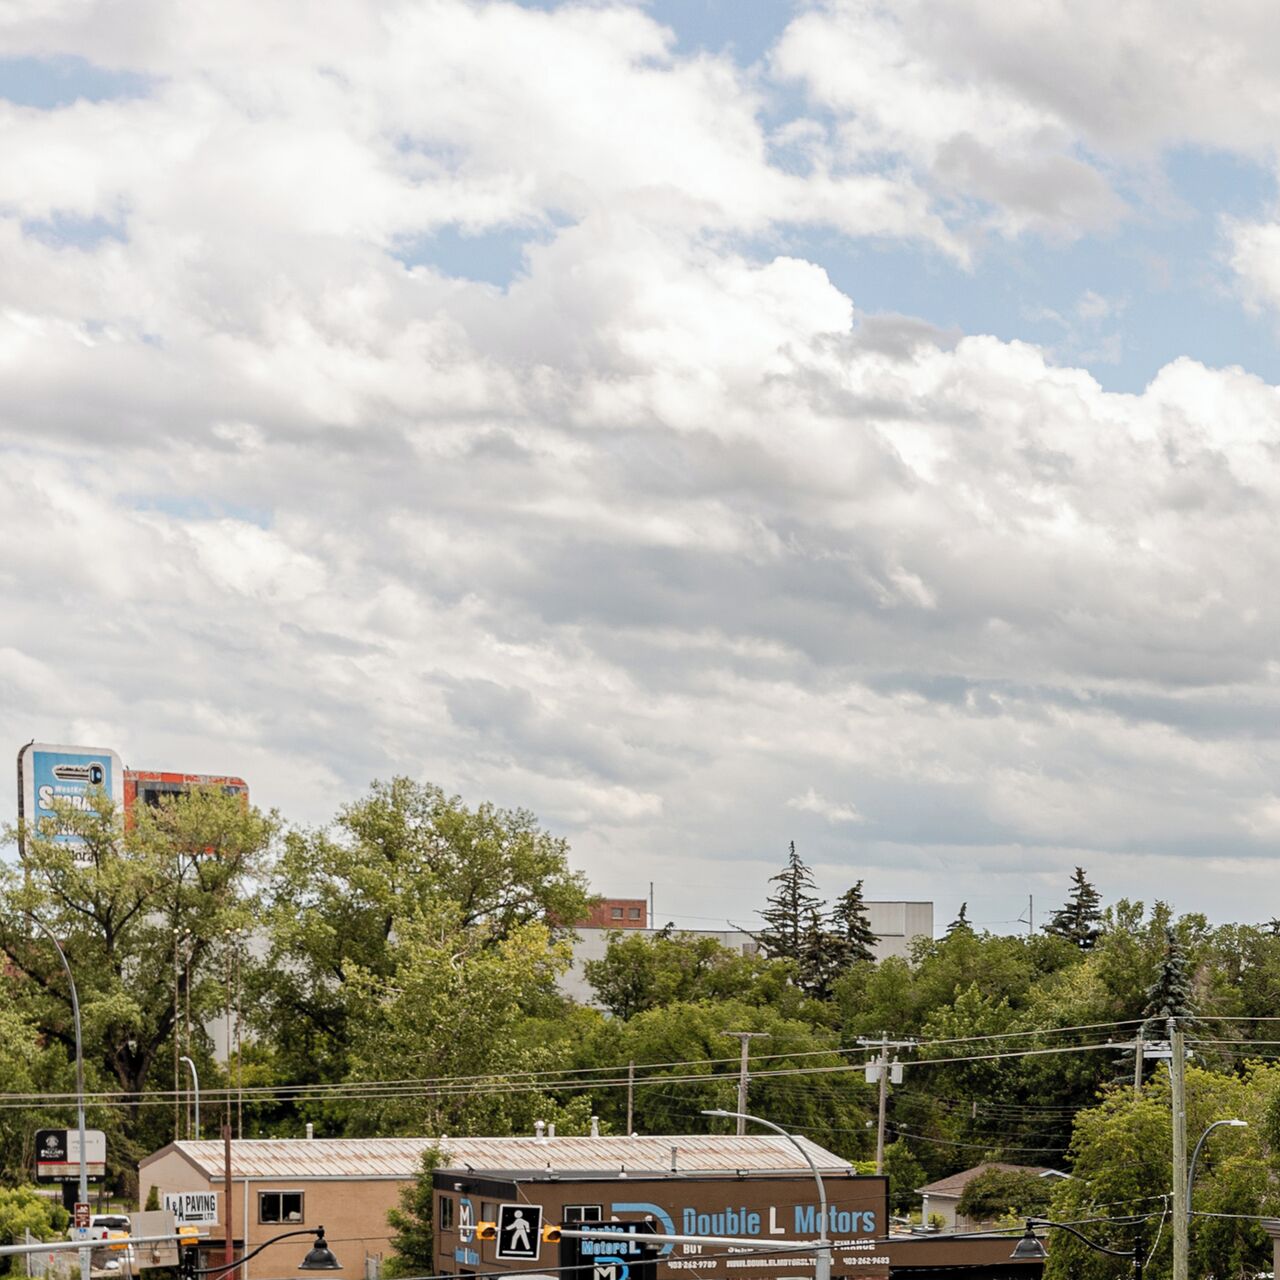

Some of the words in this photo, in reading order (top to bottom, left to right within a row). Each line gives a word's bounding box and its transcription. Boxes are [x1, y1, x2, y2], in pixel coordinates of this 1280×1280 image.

[178, 1196, 185, 1221] A
[185, 1195, 216, 1212] PAVING
[682, 1206, 761, 1236] Double
[769, 1206, 786, 1235] L
[794, 1205, 876, 1235] Motors
[581, 1241, 628, 1255] Motors
[682, 1243, 703, 1255] BUY
